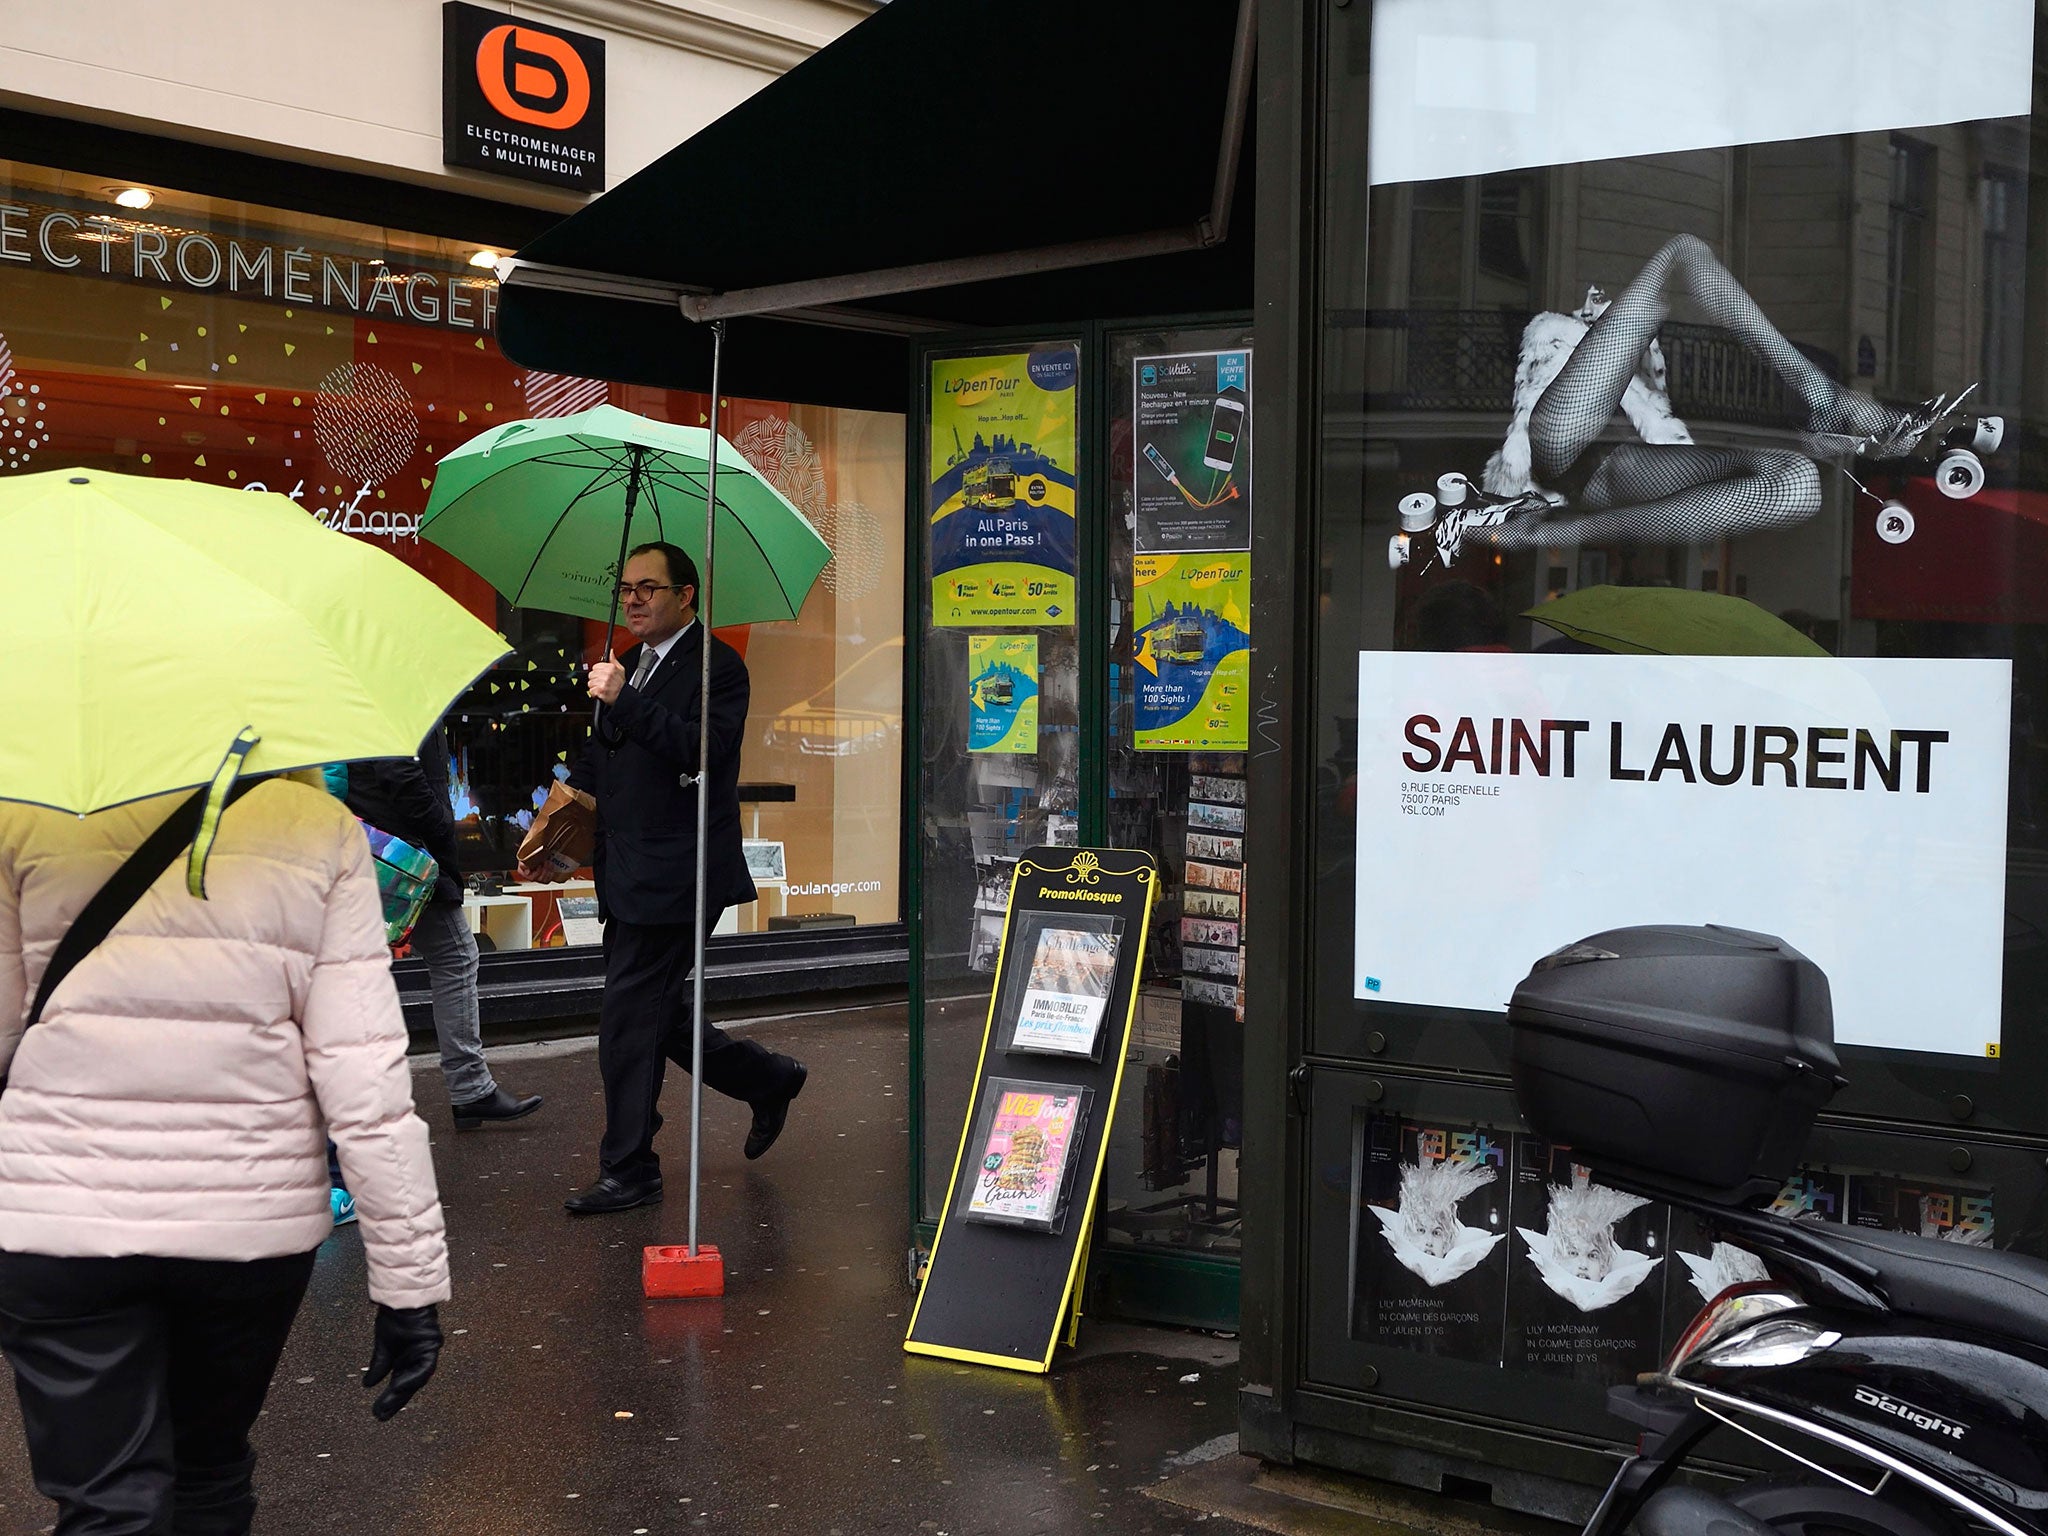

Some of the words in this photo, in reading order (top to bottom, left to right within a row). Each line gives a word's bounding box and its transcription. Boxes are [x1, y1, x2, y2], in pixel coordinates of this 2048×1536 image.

[467, 124, 596, 163] ELECTROMENAGER
[481, 145, 490, 157] &
[496, 148, 583, 177] MULTIMEDIA
[1031, 364, 1041, 373] EN
[1041, 363, 1061, 372] VENTE
[1220, 366, 1244, 374] VENTE
[978, 520, 994, 532] All
[997, 518, 1028, 531] Paris
[966, 535, 977, 547] in
[980, 536, 1001, 547] one
[1005, 534, 1034, 546] Pass
[1135, 568, 1157, 577] here
[957, 584, 963, 597] 1
[993, 583, 1000, 596] 4
[1028, 583, 1043, 596] 50
[970, 607, 1037, 617] www.opentour.com
[1143, 684, 1163, 693] More
[1165, 684, 1183, 693] than
[1143, 695, 1159, 703] 100
[1160, 695, 1185, 705] Sights
[1209, 720, 1219, 728] 50
[1402, 714, 1589, 778] SAINT
[1610, 721, 1949, 794] LAURENT
[1410, 782, 1430, 792] RUE
[1432, 784, 1445, 793] DE
[1448, 784, 1500, 796] GRENELLE
[1401, 794, 1429, 804] 75007
[1432, 795, 1460, 806] PARIS
[1401, 805, 1445, 816] YSL.COM
[780, 880, 881, 897] boulanger.com
[1039, 887, 1123, 904] PromoKiosque
[1033, 999, 1088, 1015] IMMOBILIER
[1031, 1010, 1047, 1019] Paris
[1019, 1017, 1033, 1028] Les
[1035, 1020, 1052, 1032] prix
[1989, 1045, 1996, 1056] 5
[1004, 1093, 1044, 1116] Vital
[1379, 1300, 1395, 1308] LILY
[1379, 1313, 1387, 1321] IN
[1390, 1313, 1420, 1322] COMME
[1423, 1313, 1439, 1321] DES
[1440, 1313, 1479, 1323] GARÇONS
[1379, 1326, 1390, 1335] BY
[1393, 1326, 1421, 1336] JULIEN
[1526, 1326, 1543, 1335] LILY
[1527, 1339, 1536, 1348] IN
[1539, 1339, 1572, 1349] COMME
[1574, 1339, 1592, 1348] DES
[1593, 1339, 1637, 1350] GARÇONS
[1527, 1353, 1540, 1361] BY
[1542, 1353, 1573, 1362] JULIEN
